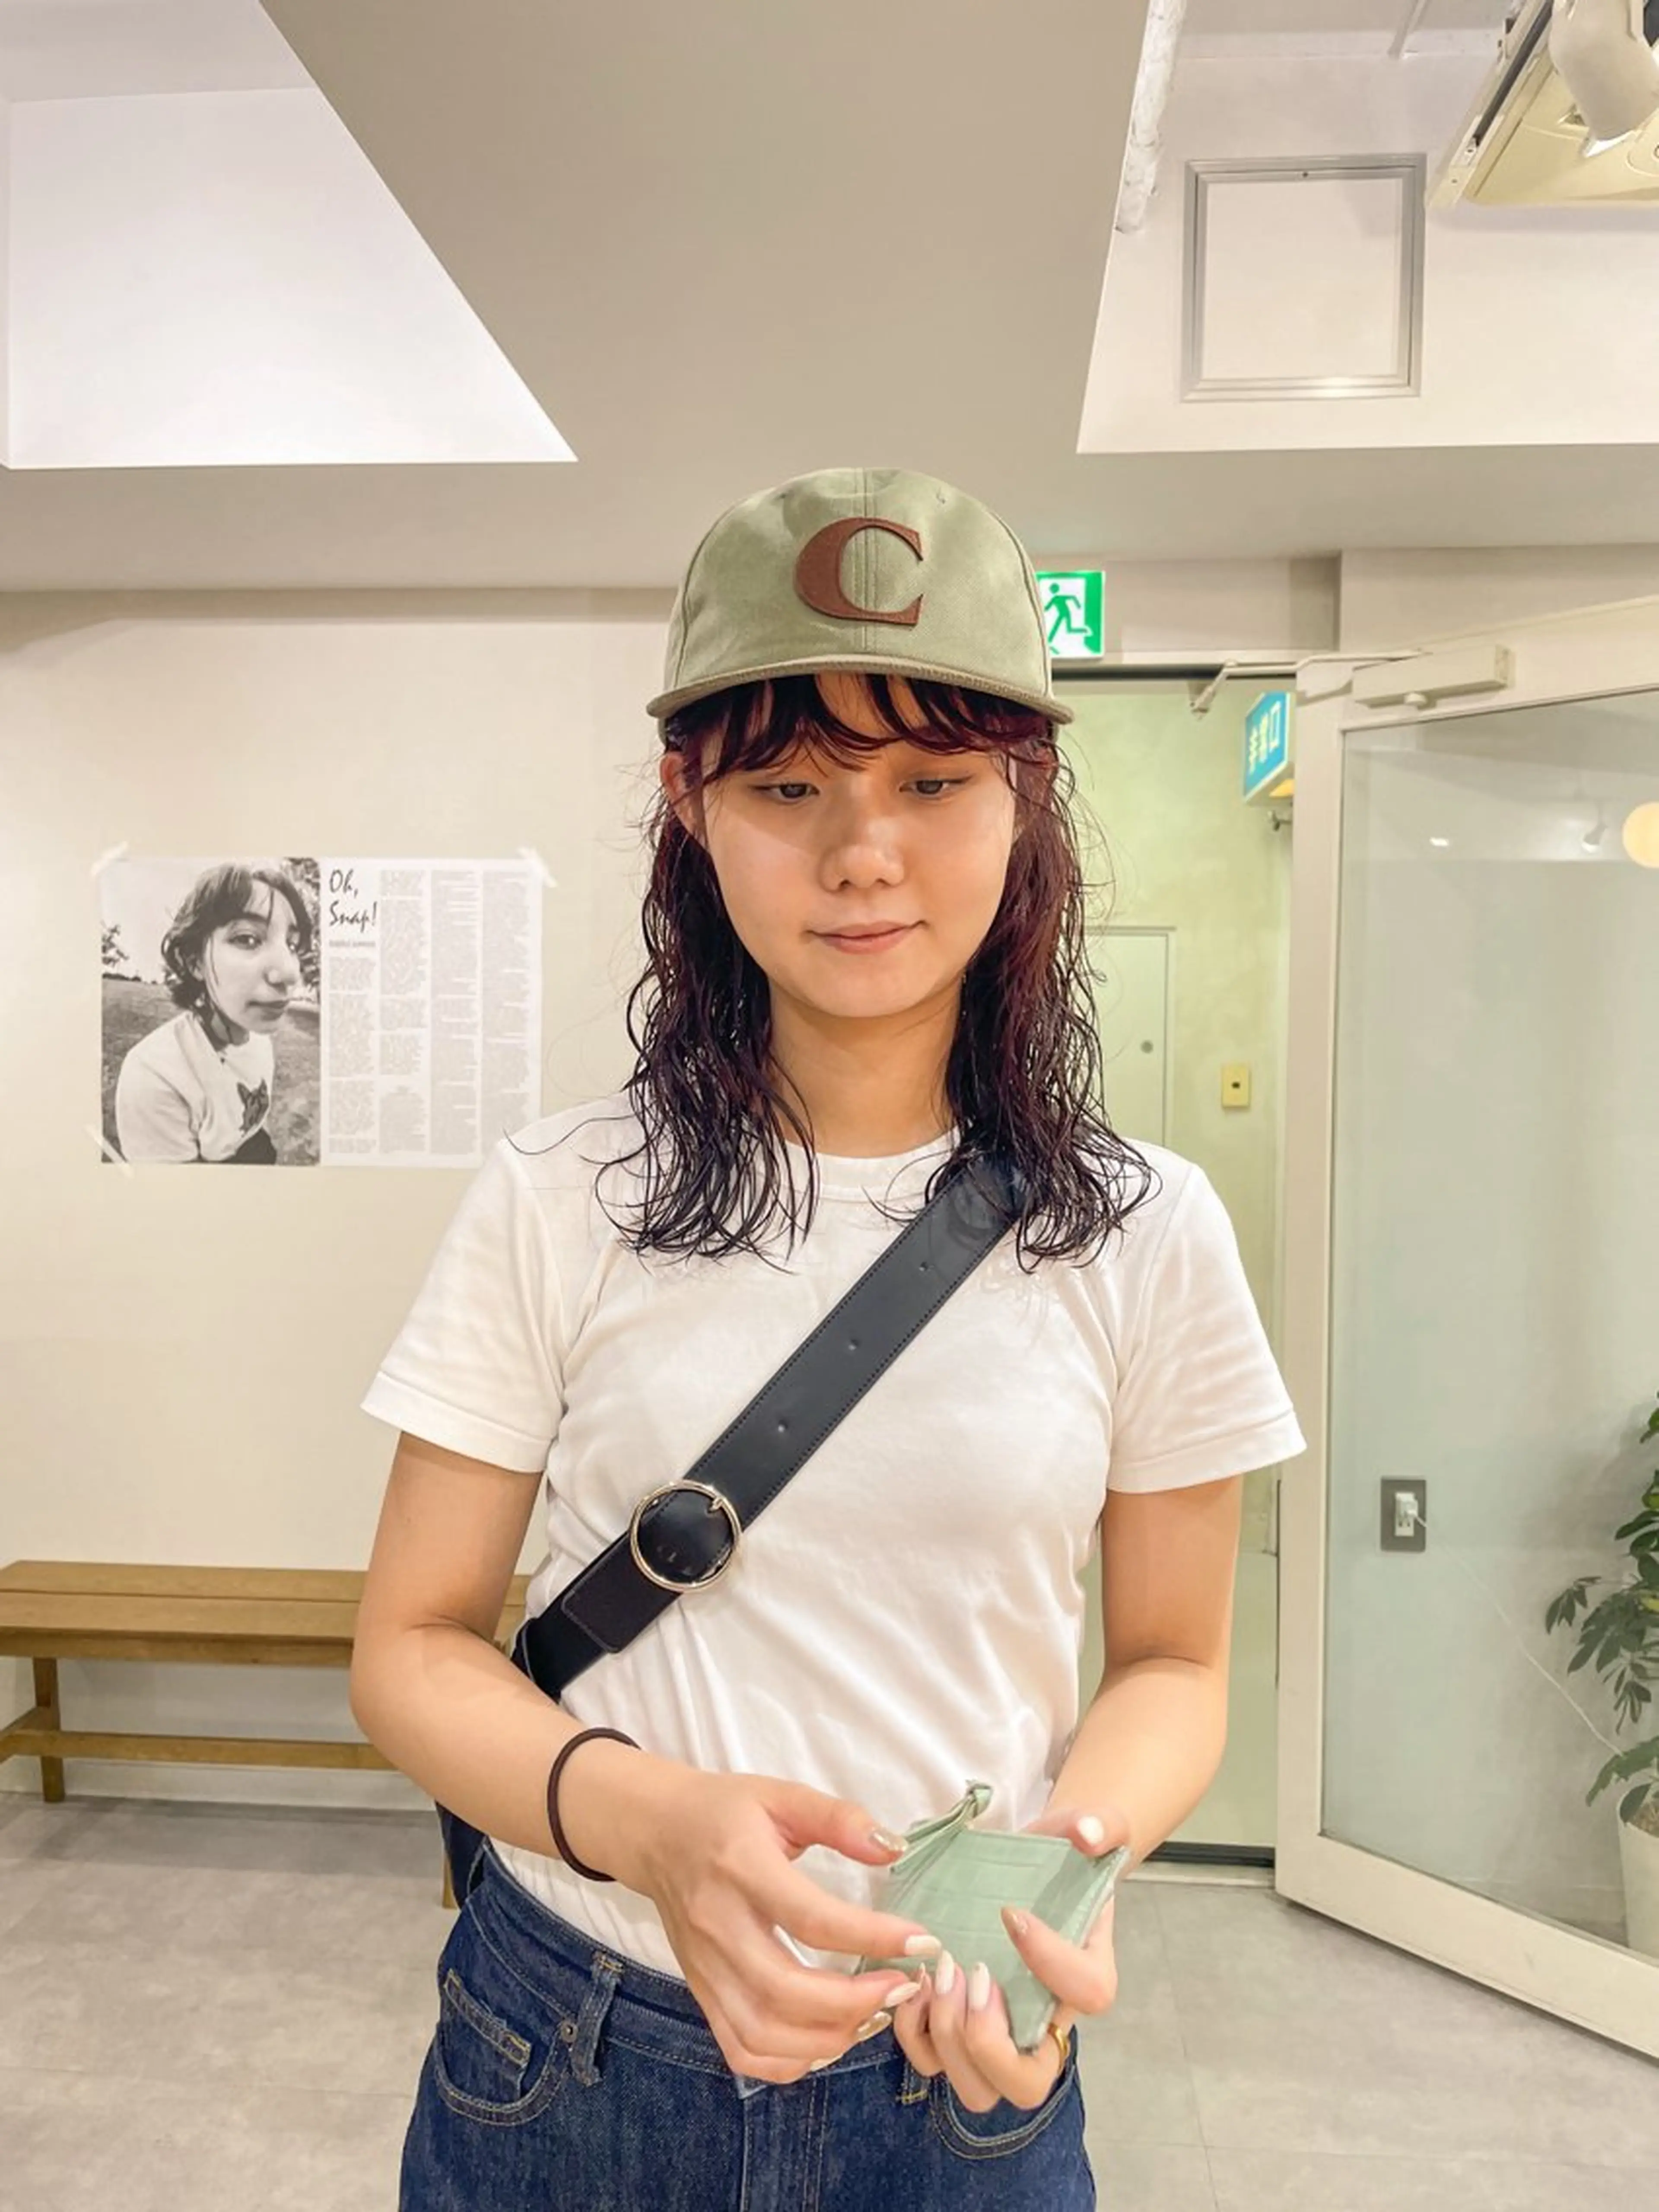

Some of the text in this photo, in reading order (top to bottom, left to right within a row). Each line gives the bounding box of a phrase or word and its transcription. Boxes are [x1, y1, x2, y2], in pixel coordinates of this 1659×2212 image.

[795, 517, 923, 626] C
[330, 869, 358, 899] Oh,
[330, 900, 377, 933] Snap!
